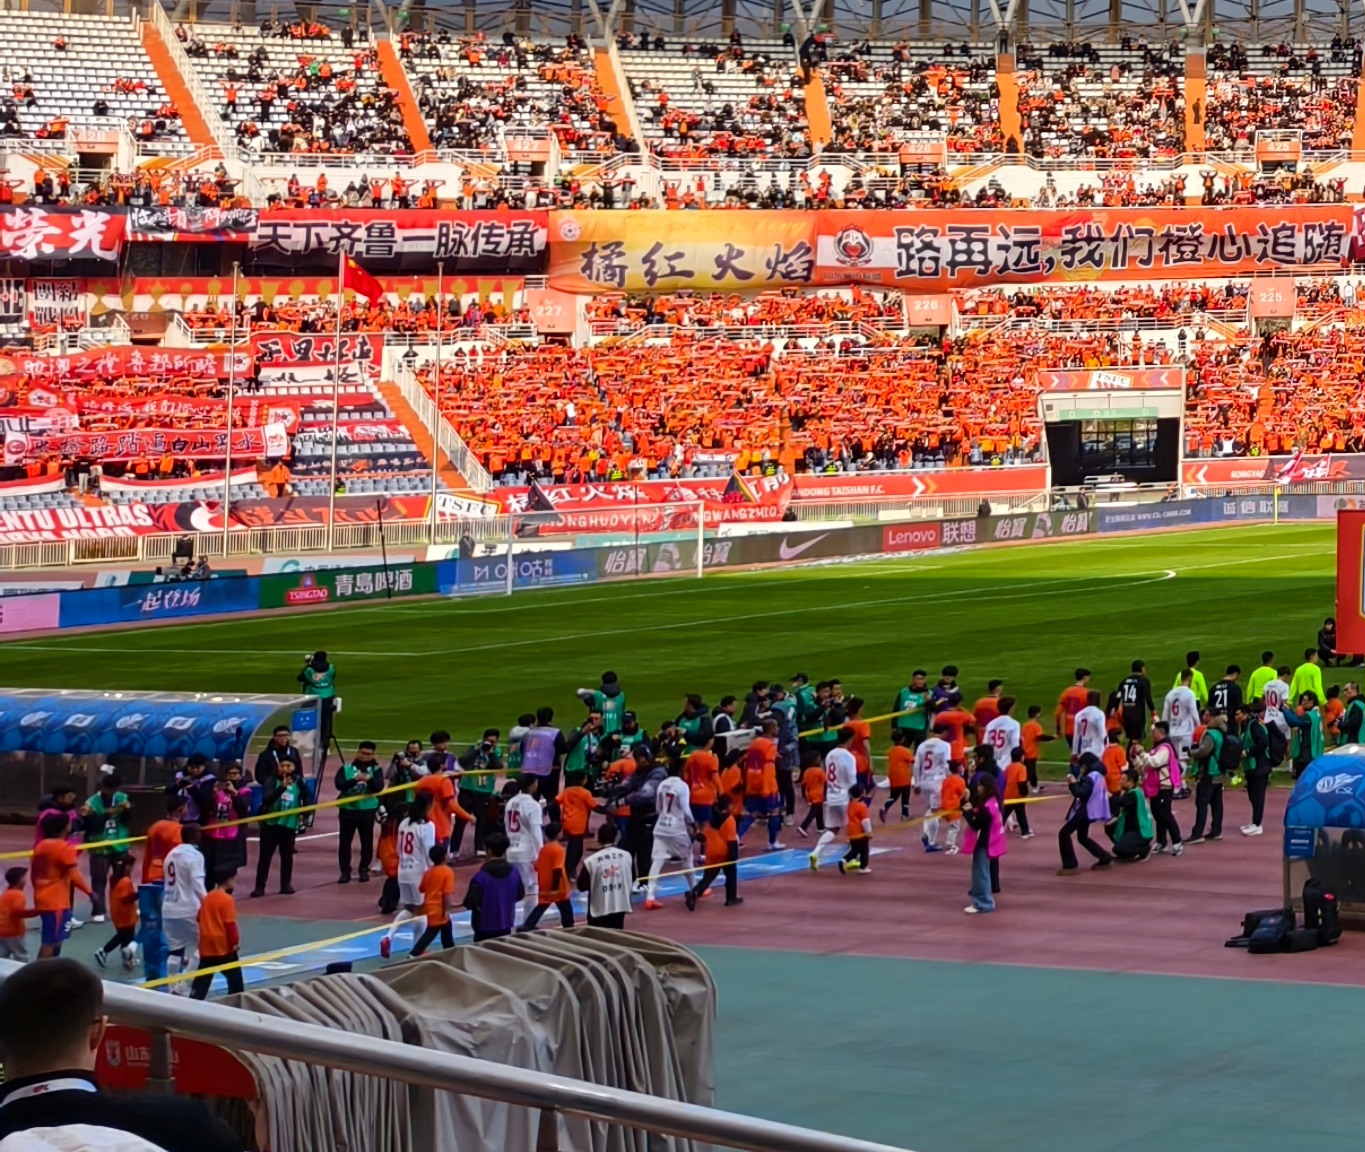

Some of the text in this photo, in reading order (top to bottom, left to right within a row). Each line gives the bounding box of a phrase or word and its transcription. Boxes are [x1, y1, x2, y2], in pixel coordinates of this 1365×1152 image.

[257, 219, 539, 257] 天下齐鲁一脉传承
[895, 220, 1347, 278] 路再远,我们橙心追随
[580, 240, 815, 287] 橘红火焰
[536, 306, 562, 317] 227
[832, 485, 870, 496] TAISHAN
[439, 495, 493, 516] TSFC
[56, 503, 153, 529] ULTRAS
[888, 521, 977, 546] Lenovo 联想
[289, 588, 329, 601] TSINGTAO
[1122, 684, 1138, 703] 14
[1214, 689, 1229, 709] 21
[1265, 690, 1278, 708] 10
[1172, 698, 1181, 717] 6
[1080, 719, 1089, 738] 7
[988, 729, 1006, 749] 35
[923, 751, 934, 771] 5
[828, 762, 837, 783] 8
[1335, 787, 1354, 795] CSL
[507, 809, 521, 833] 15
[399, 831, 414, 855] 18
[168, 861, 176, 887] 9
